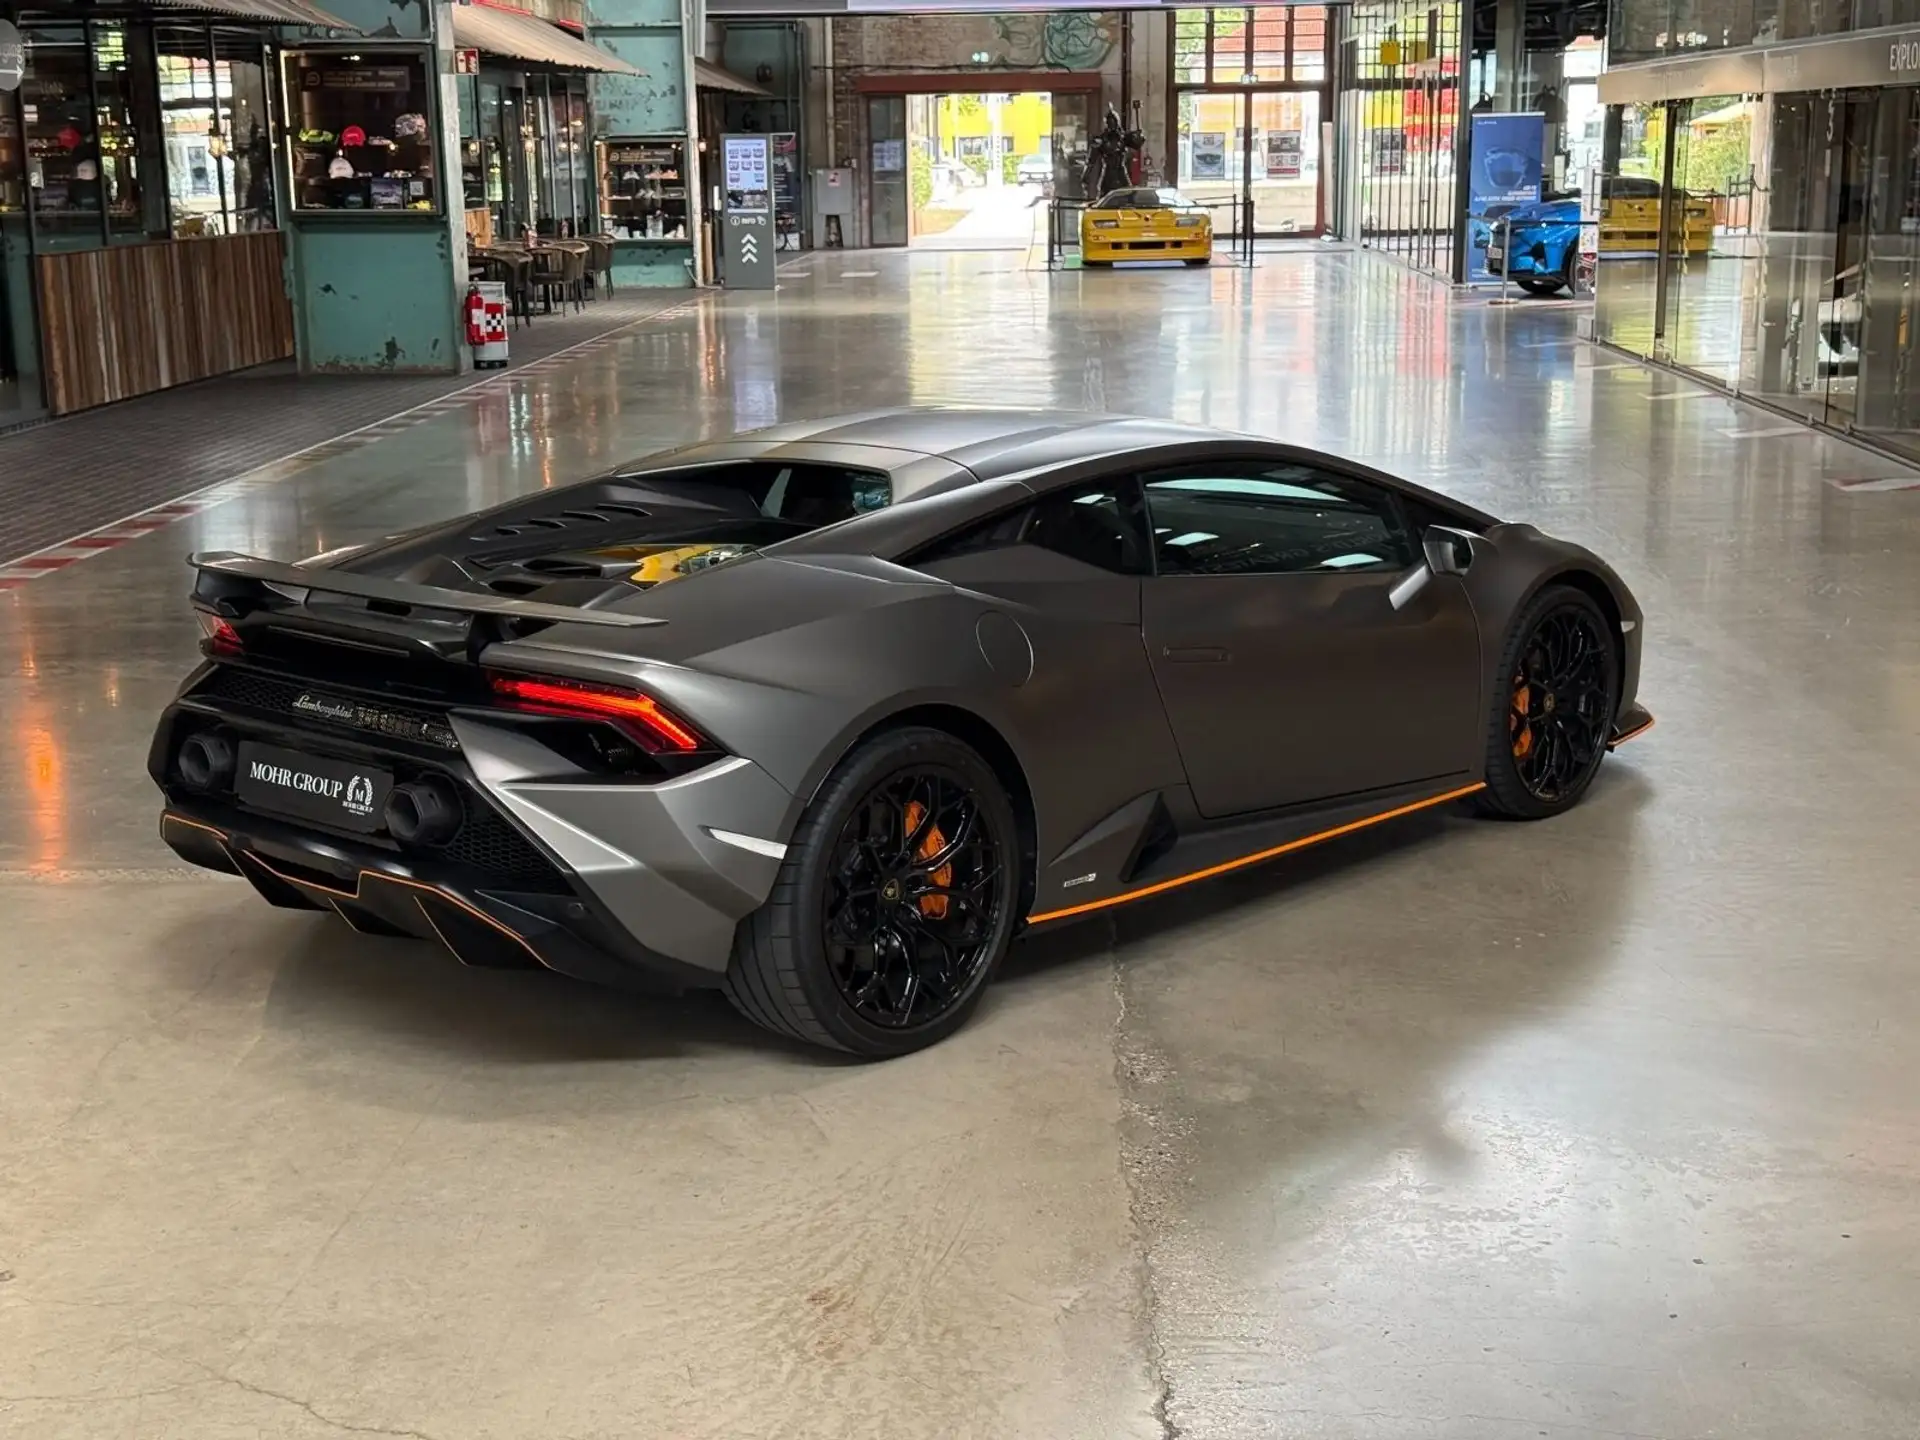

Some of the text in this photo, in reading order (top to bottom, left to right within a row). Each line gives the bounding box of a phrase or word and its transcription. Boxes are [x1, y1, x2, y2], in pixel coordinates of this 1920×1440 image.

[1890, 41, 1920, 71] EXPLO
[292, 695, 353, 718] Lamborghini
[250, 761, 343, 798] MOHR GROUP
[355, 788, 364, 802] M
